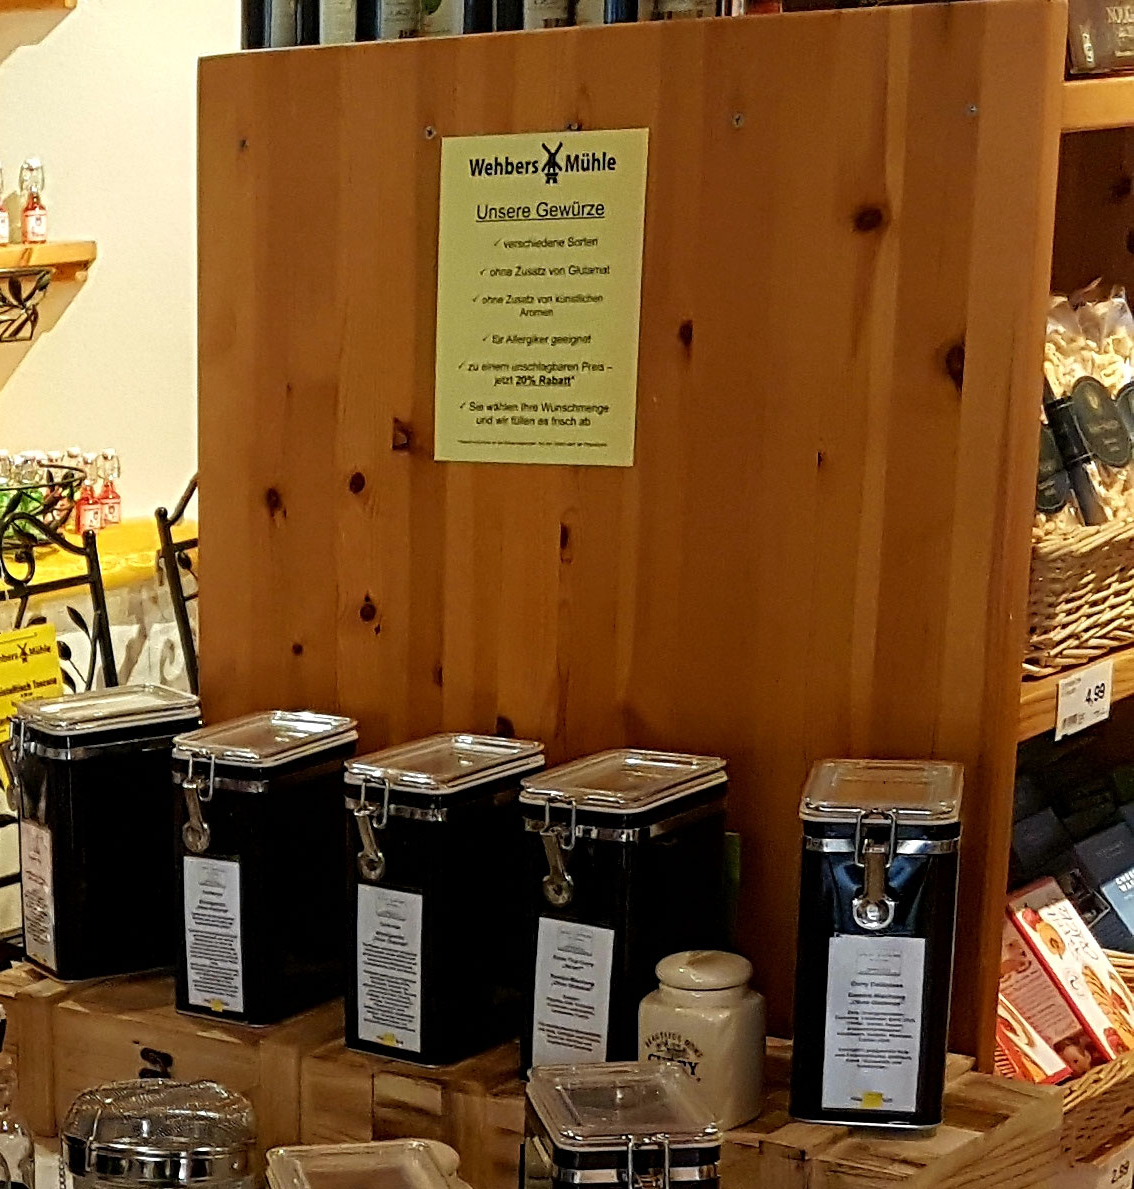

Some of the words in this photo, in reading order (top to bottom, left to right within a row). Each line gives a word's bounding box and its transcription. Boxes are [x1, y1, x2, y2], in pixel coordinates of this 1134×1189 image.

[469, 156, 539, 177] Wehbers
[566, 151, 617, 173] Mühle
[476, 204, 531, 220] Unsere
[536, 201, 606, 218] Gewürze
[568, 237, 598, 248] Sorten
[549, 267, 566, 276] von
[515, 376, 536, 386] 20%
